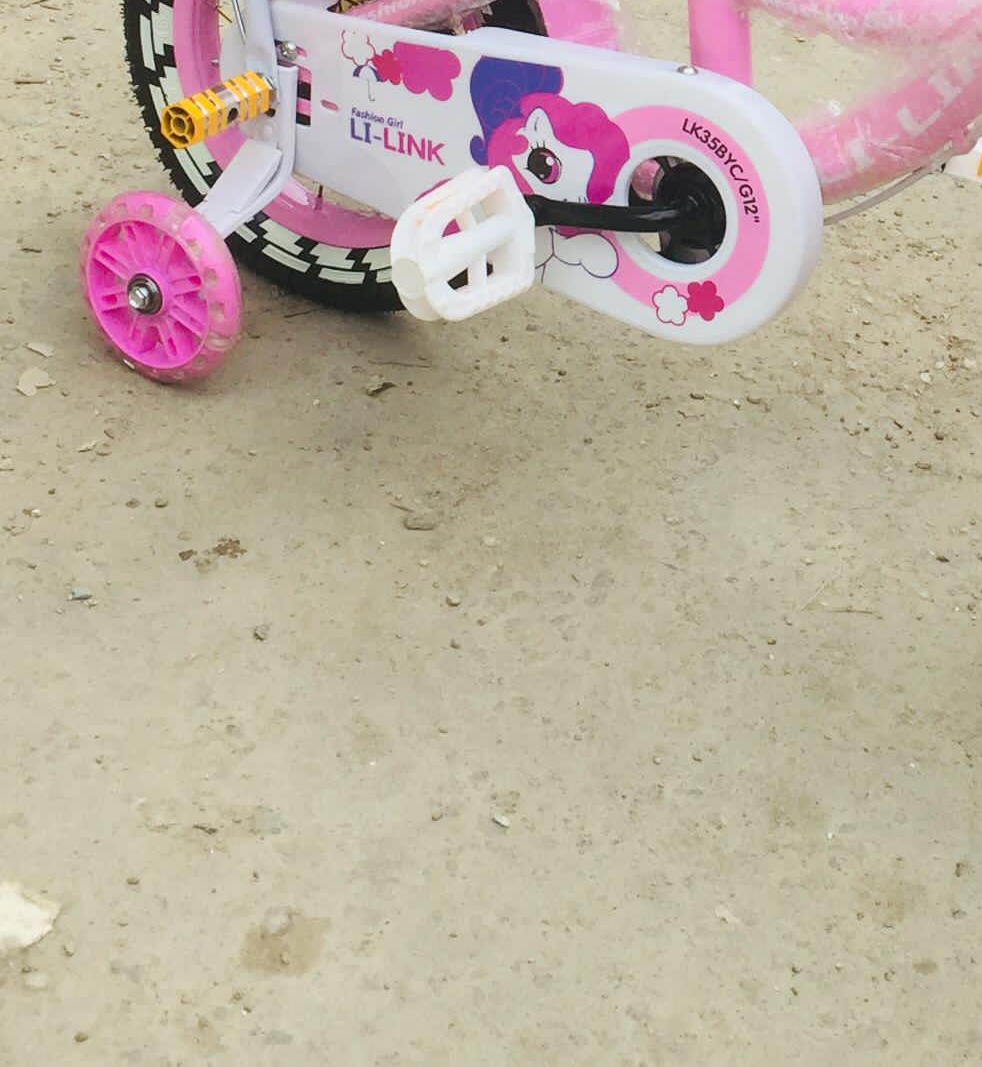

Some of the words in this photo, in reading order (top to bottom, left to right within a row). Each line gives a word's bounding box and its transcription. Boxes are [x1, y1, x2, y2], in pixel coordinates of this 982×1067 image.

[350, 117, 446, 166] LI-LINK
[351, 106, 385, 124] Fashion
[386, 116, 405, 130] Girl
[682, 117, 761, 224] LK35BYC/G12"
